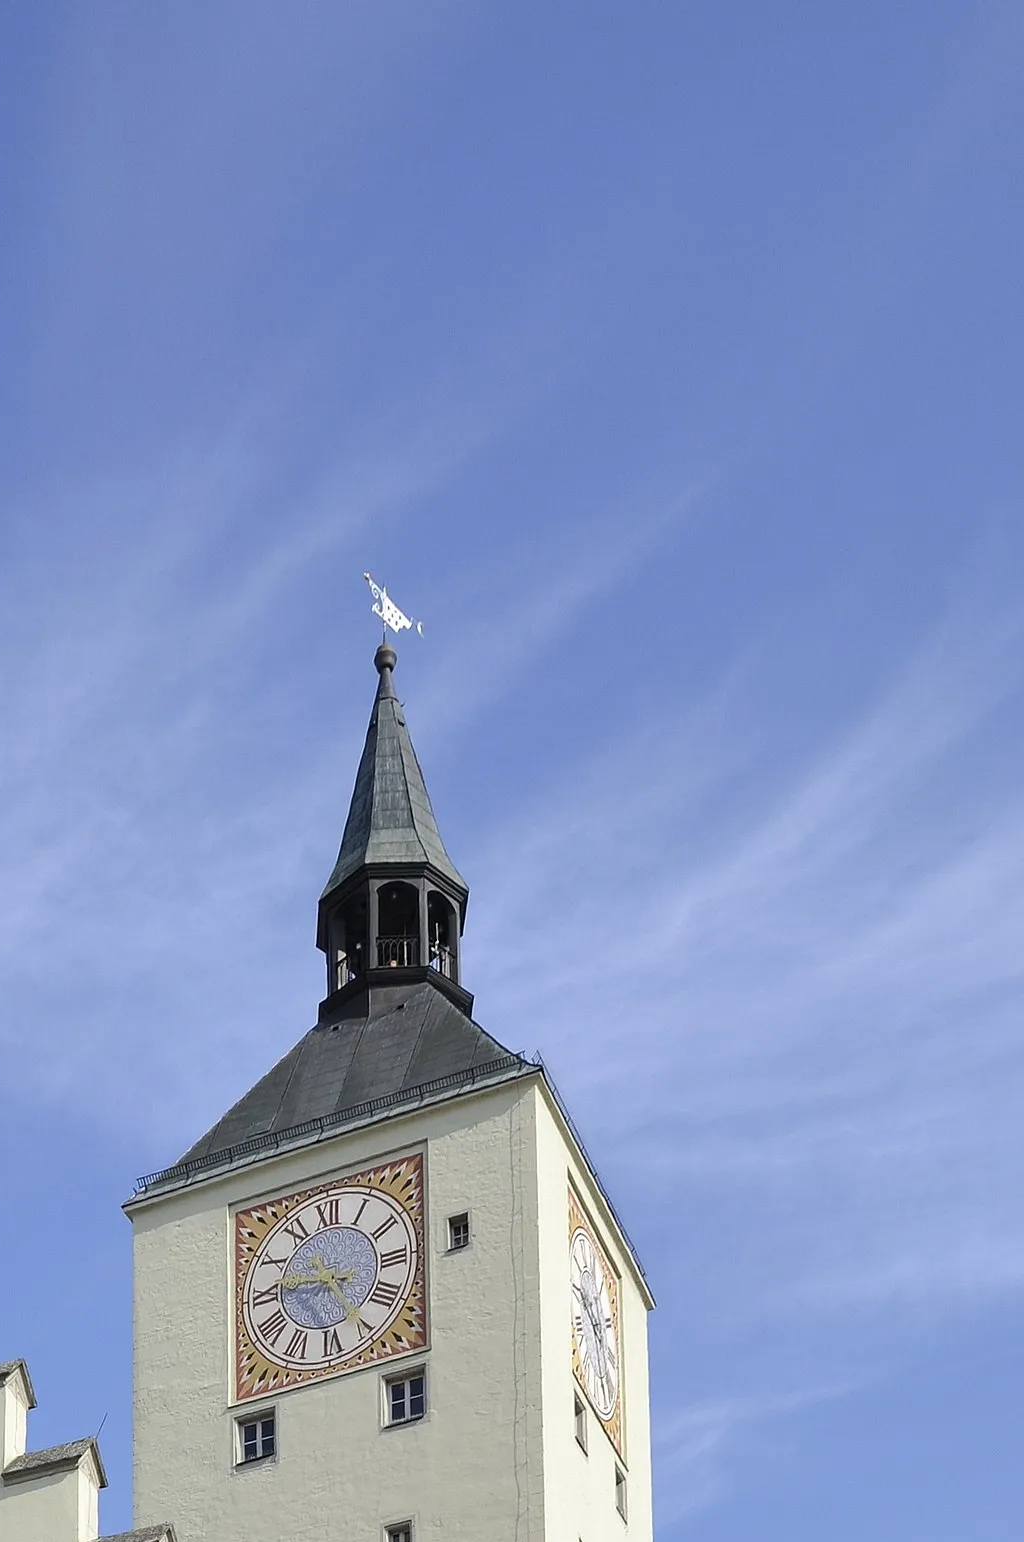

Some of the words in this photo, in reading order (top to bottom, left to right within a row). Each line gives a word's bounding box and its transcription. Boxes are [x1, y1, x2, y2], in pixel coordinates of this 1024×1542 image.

[315, 1198, 341, 1231] XII
[351, 1198, 370, 1226] I
[283, 1215, 311, 1250] XI
[370, 1214, 398, 1242] II
[260, 1251, 288, 1272] X
[380, 1244, 407, 1271] III
[253, 1282, 279, 1309] IX
[257, 1309, 288, 1347] VIII
[356, 1317, 376, 1341] V
[283, 1328, 308, 1359] VII
[322, 1330, 345, 1358] VI
